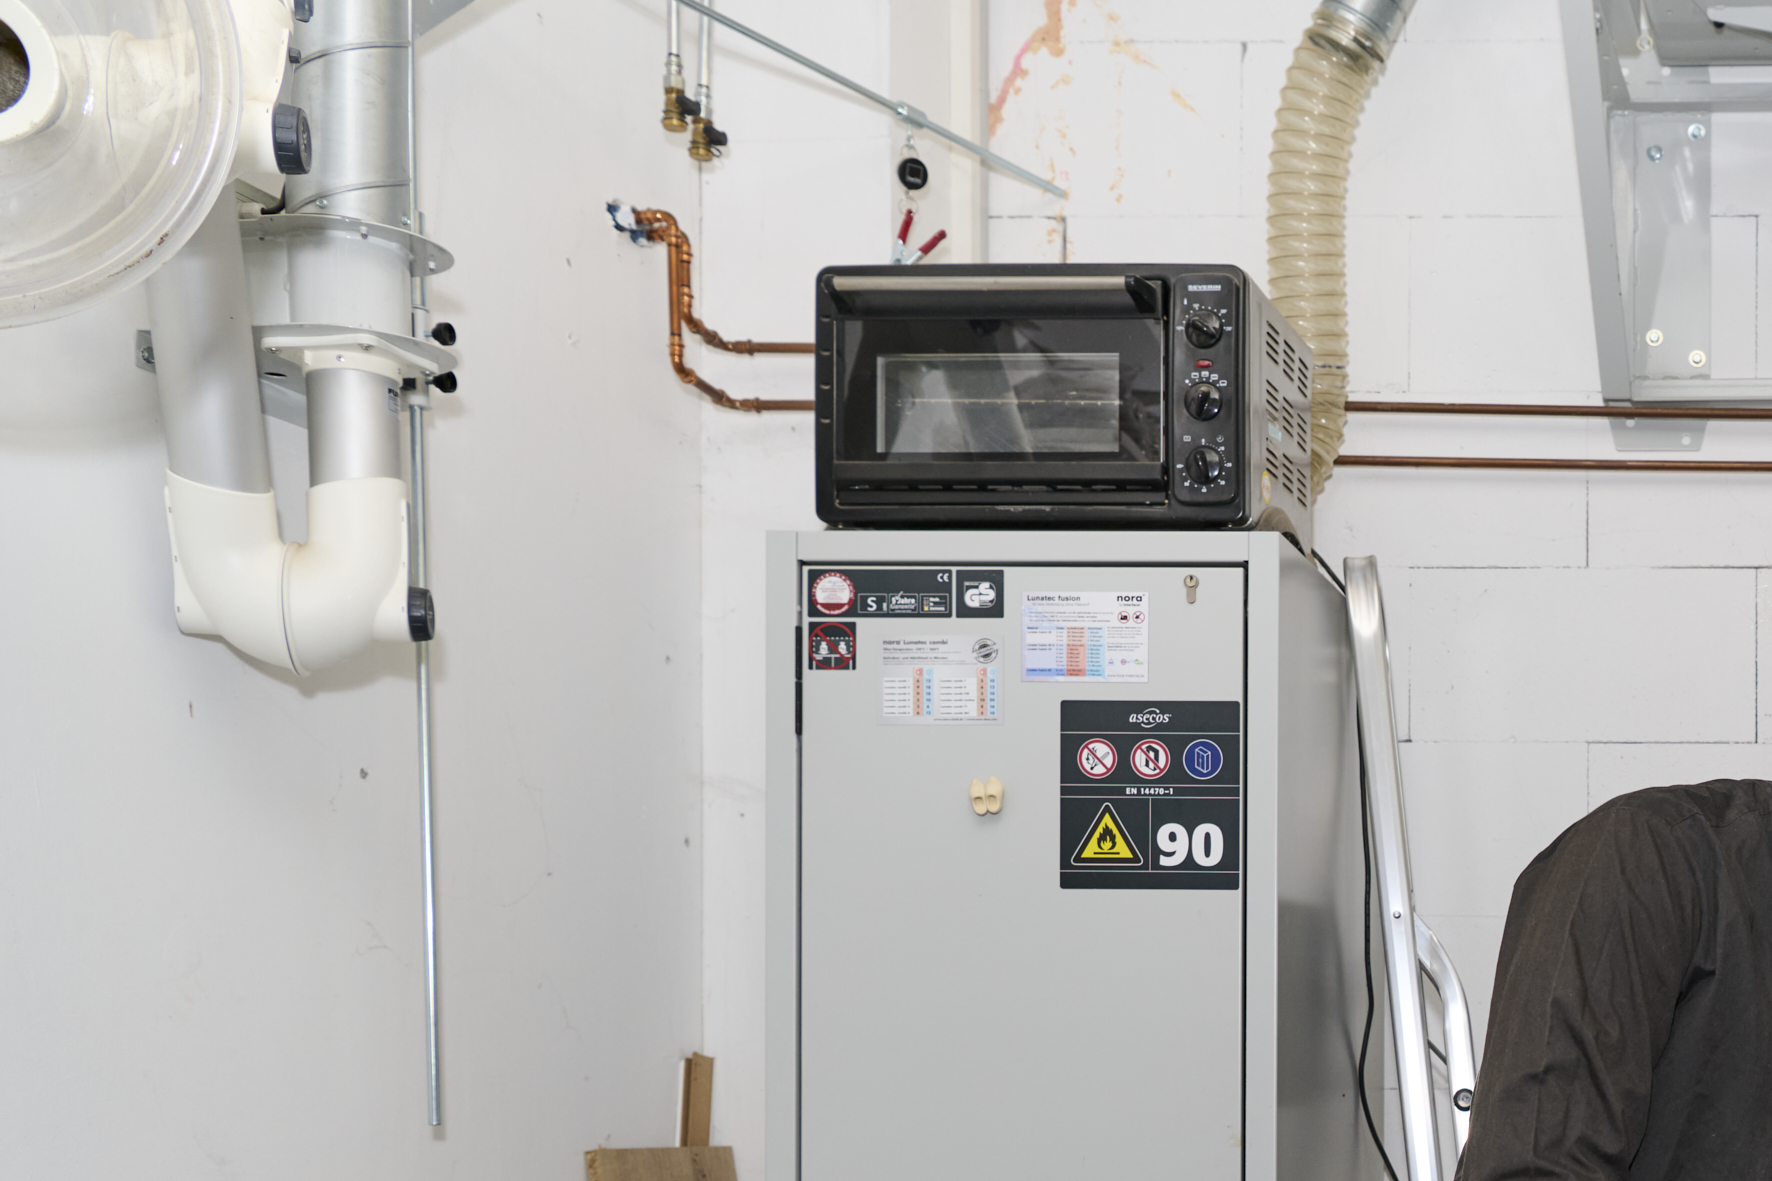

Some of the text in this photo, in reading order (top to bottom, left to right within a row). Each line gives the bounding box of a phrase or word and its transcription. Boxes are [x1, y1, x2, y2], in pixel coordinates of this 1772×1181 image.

[937, 573, 949, 582] CE
[964, 582, 996, 608] GS
[867, 597, 877, 611] S
[1129, 713, 1170, 723] asecos
[1156, 822, 1224, 867] 90
